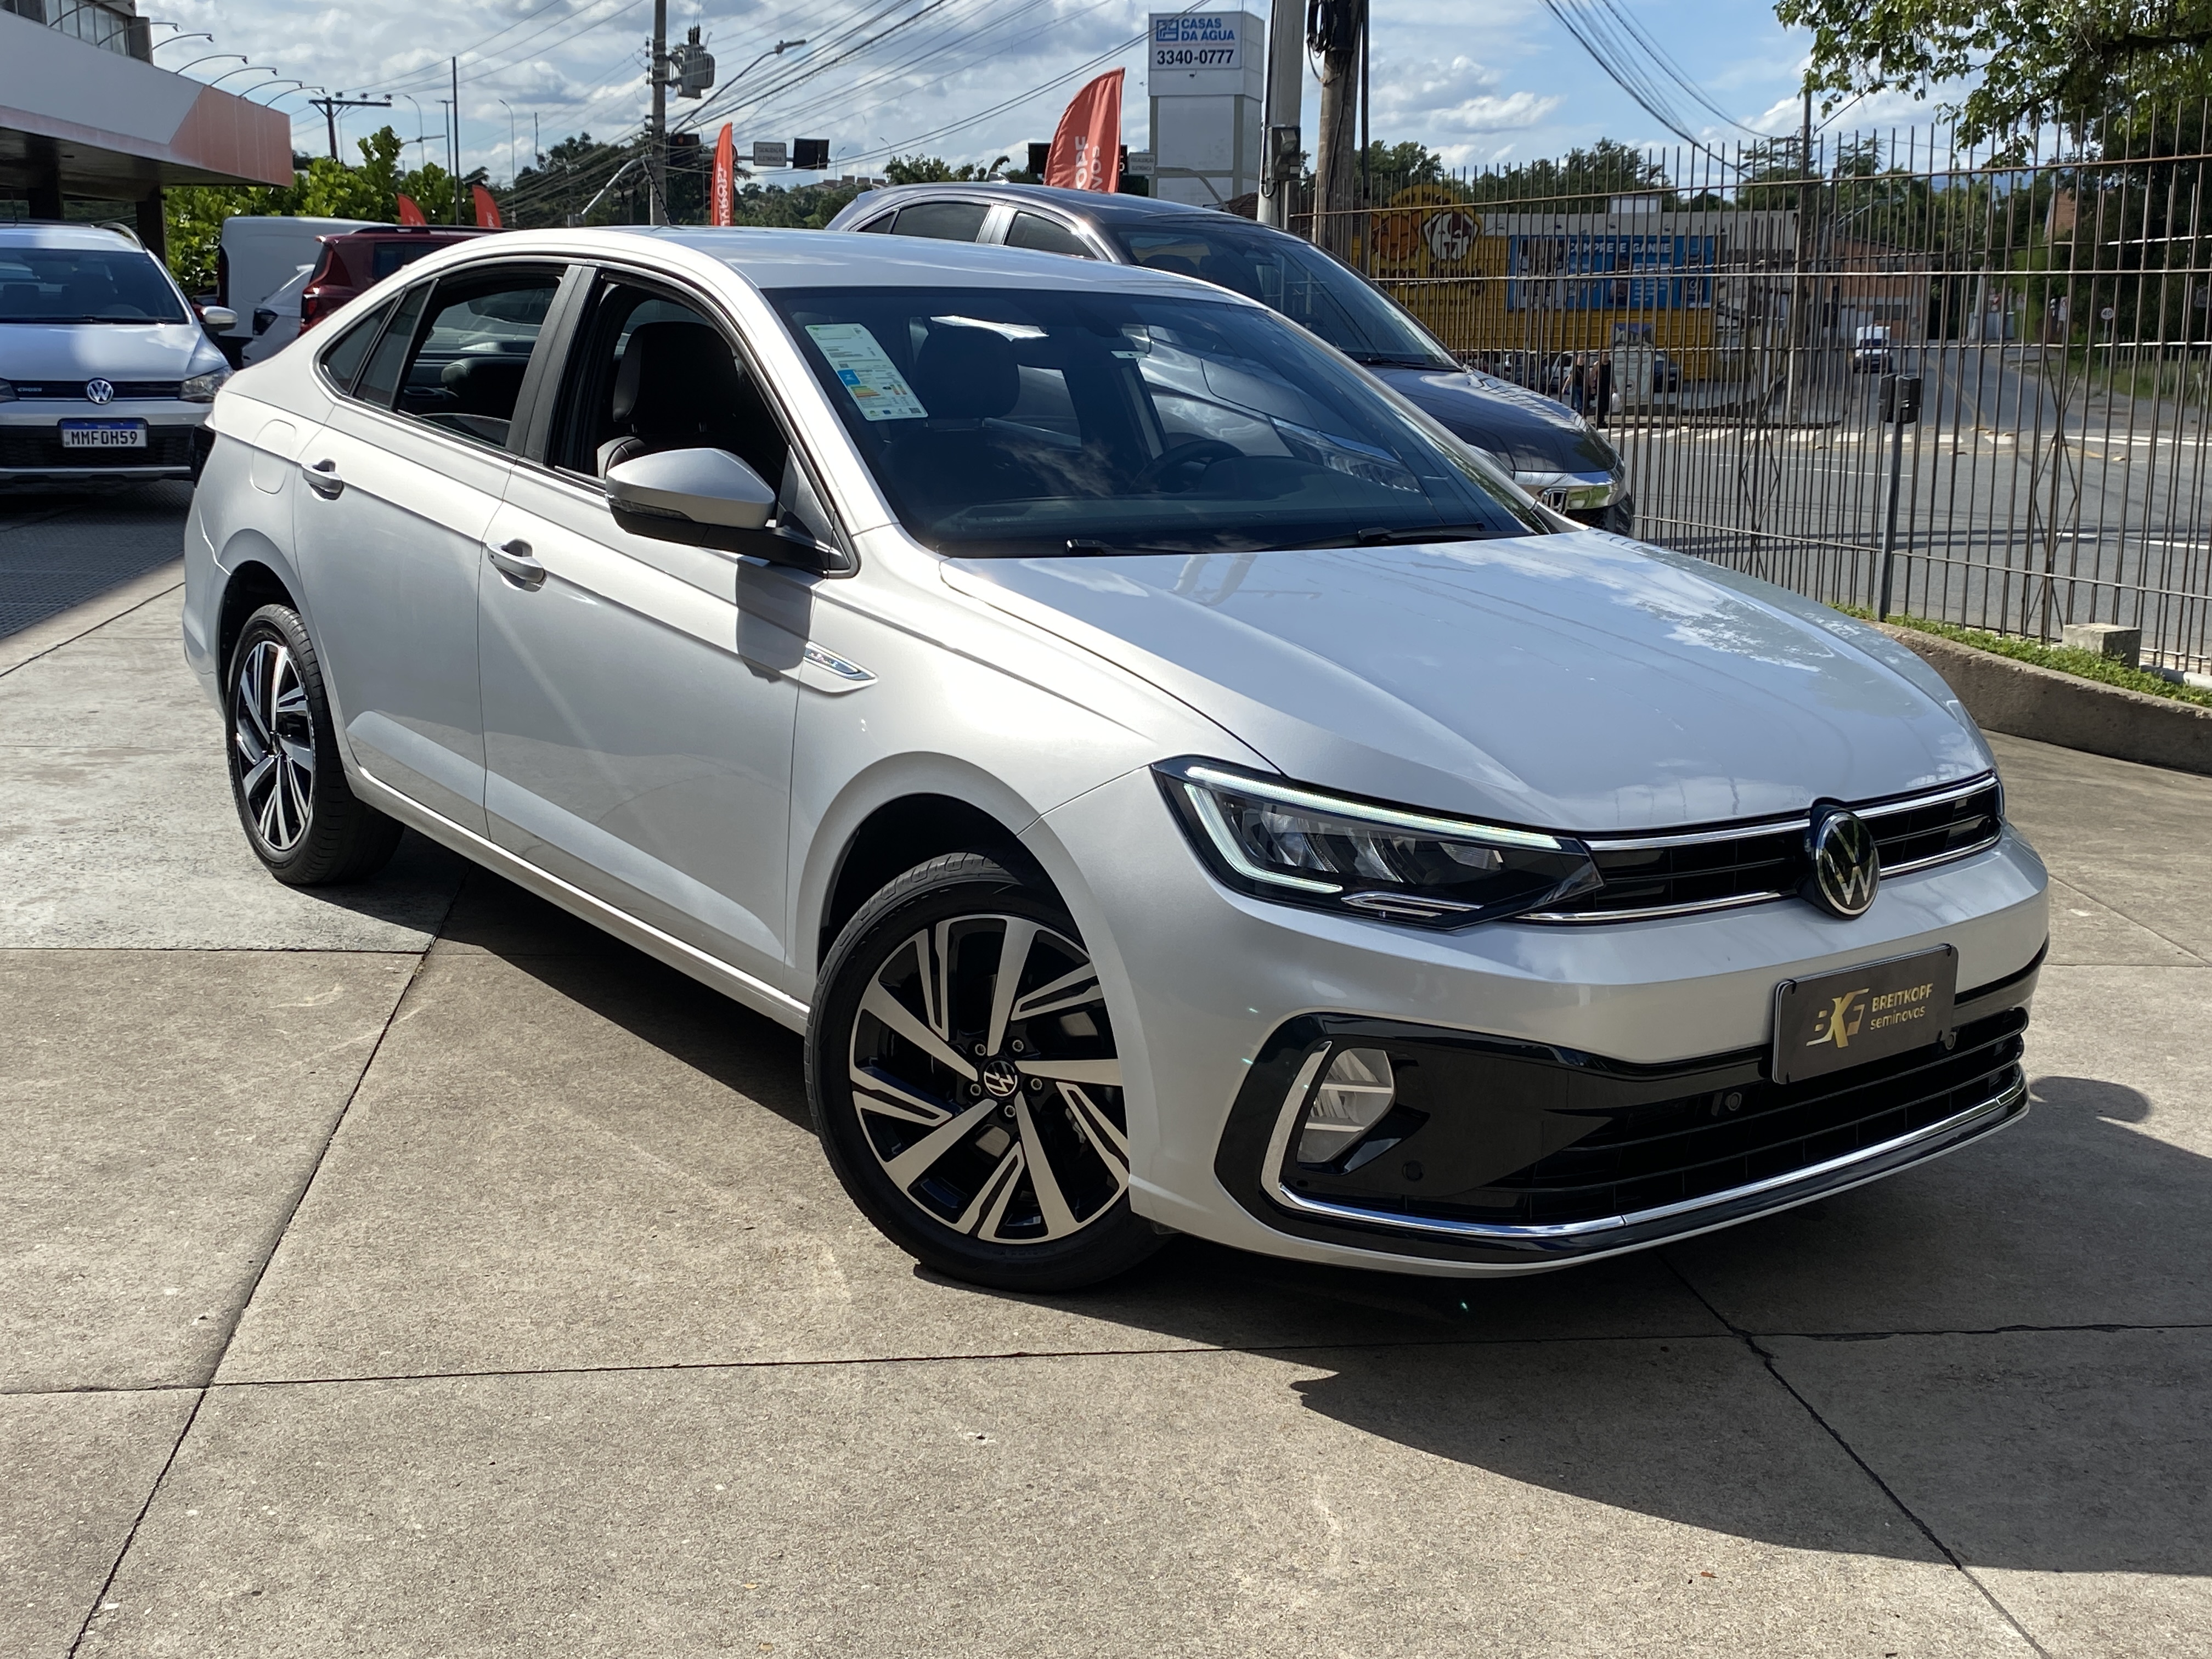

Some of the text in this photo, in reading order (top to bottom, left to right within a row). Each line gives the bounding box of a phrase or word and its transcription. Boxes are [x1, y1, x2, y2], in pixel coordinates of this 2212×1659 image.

[1182, 18, 1222, 29] CASAS
[1181, 29, 1235, 41] DA ÁGUA
[1157, 49, 1234, 65] 3340-0777
[1871, 983, 1933, 1013] BREITKOPF
[1870, 1006, 1926, 1030] seminovos
